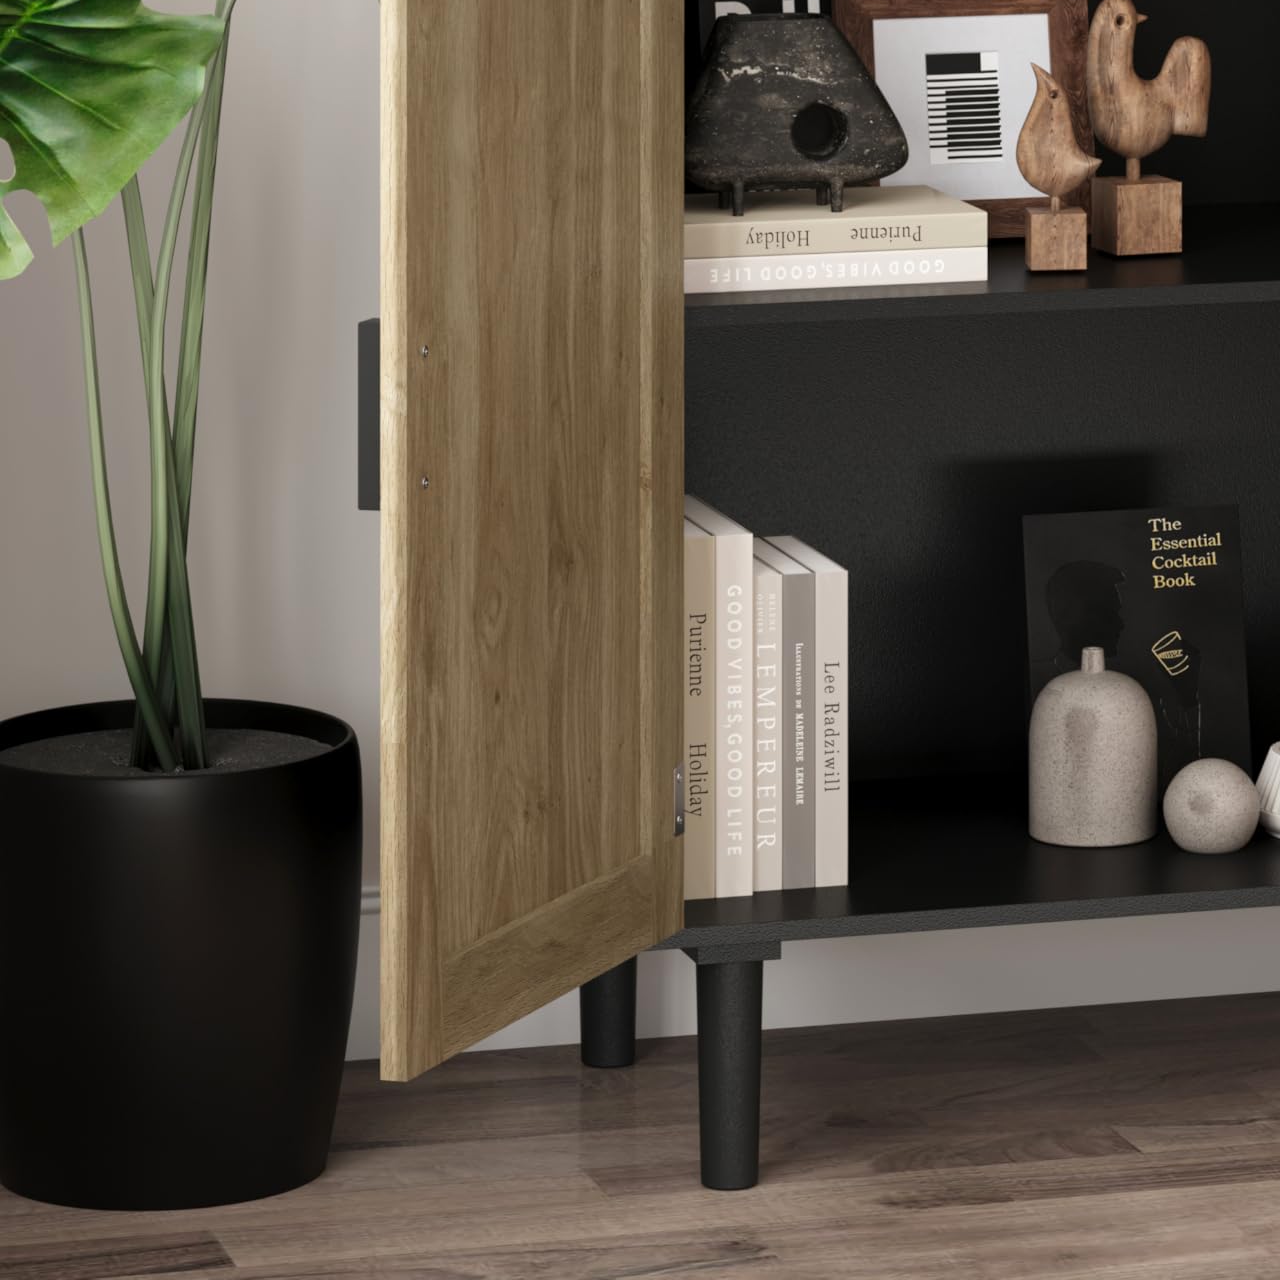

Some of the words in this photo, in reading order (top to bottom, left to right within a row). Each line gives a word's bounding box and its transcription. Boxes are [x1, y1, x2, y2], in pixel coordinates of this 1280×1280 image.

[745, 227, 810, 249] Holiday
[850, 225, 922, 243] Purienne
[709, 267, 752, 284] LIFE
[759, 264, 817, 281] GOOD
[888, 258, 945, 275] GOOD
[1148, 518, 1182, 533] The
[1150, 532, 1222, 551] Essential
[1151, 552, 1218, 570] Cocktail
[1152, 573, 1196, 589] Book
[726, 584, 744, 651] GOOD
[689, 613, 707, 697] Purienne
[824, 661, 841, 695] Lee
[756, 642, 777, 850] LEMPEREUR
[795, 712, 804, 762] MADELEINE
[824, 703, 841, 793] Radziwill
[685, 743, 709, 817] Holiday
[726, 734, 744, 799] GOOD
[795, 767, 804, 806] LEMAIRE
[727, 808, 743, 857] LIFE
